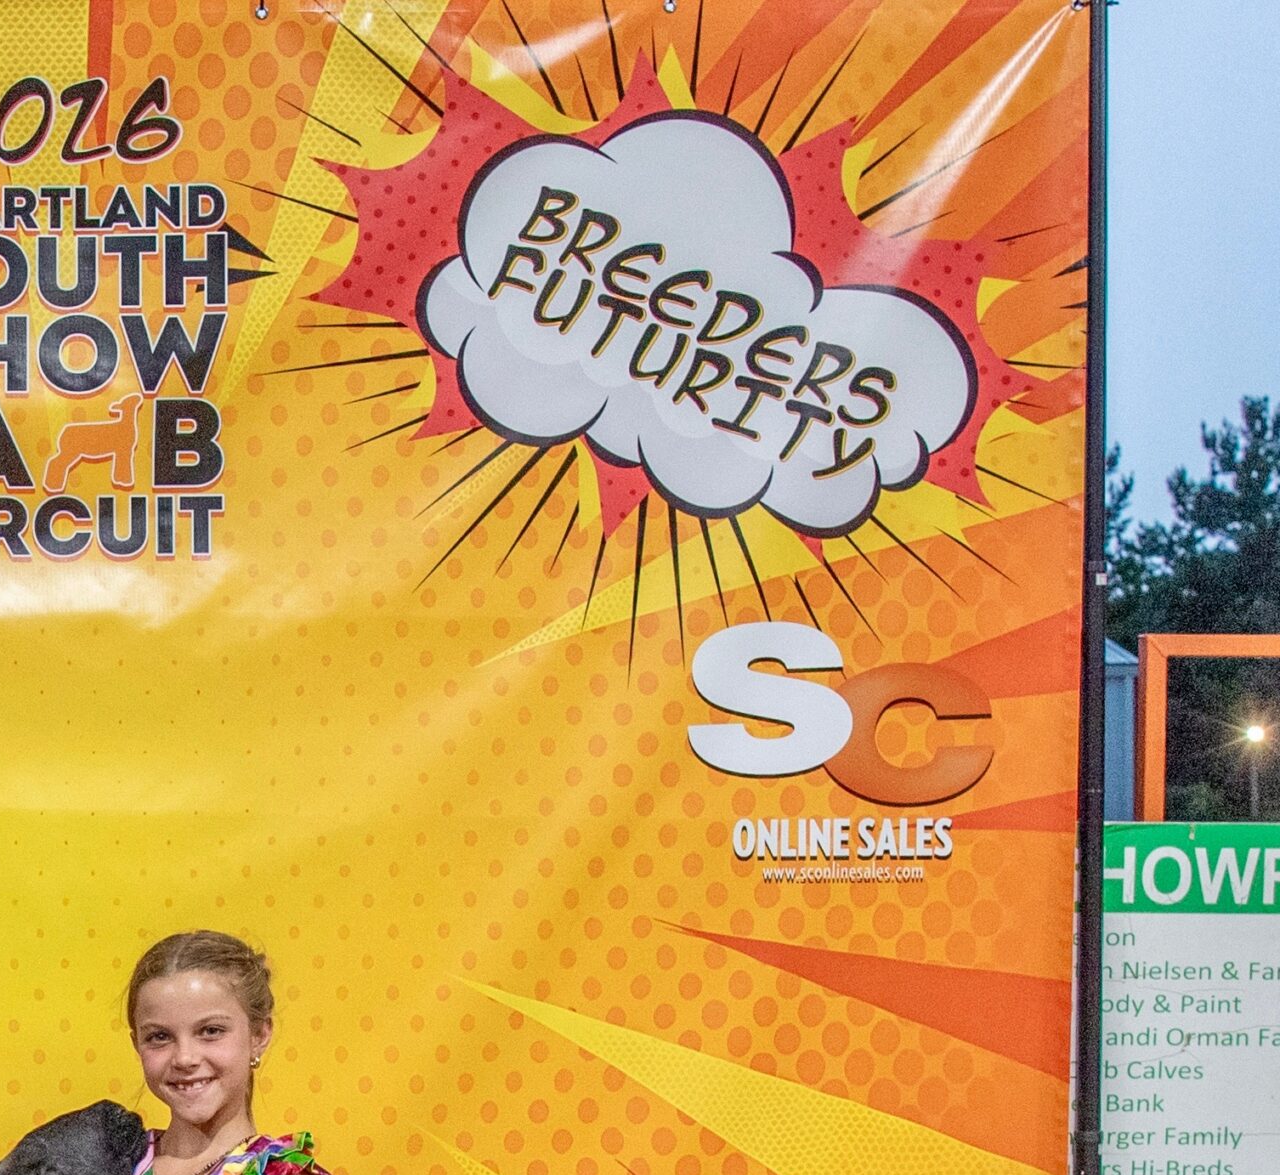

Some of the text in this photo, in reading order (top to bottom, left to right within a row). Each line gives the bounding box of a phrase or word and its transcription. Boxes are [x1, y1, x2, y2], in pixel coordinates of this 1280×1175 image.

[519, 186, 897, 429] BREEDERS
[487, 244, 875, 480] FUTURITY
[687, 621, 995, 808] SC
[732, 818, 954, 860] ONLINE SALES
[762, 862, 924, 883] www.sconlinesales.com
[1123, 961, 1212, 980] Nielsen
[1221, 962, 1239, 980] &
[1249, 962, 1280, 980] Fa
[1101, 995, 1242, 1017] ody & Paint
[1106, 1028, 1158, 1046] andi
[1167, 1029, 1249, 1047] Orman
[1127, 1061, 1204, 1080] Calves
[1106, 1094, 1165, 1112] Bank
[1165, 1126, 1243, 1150] Family
